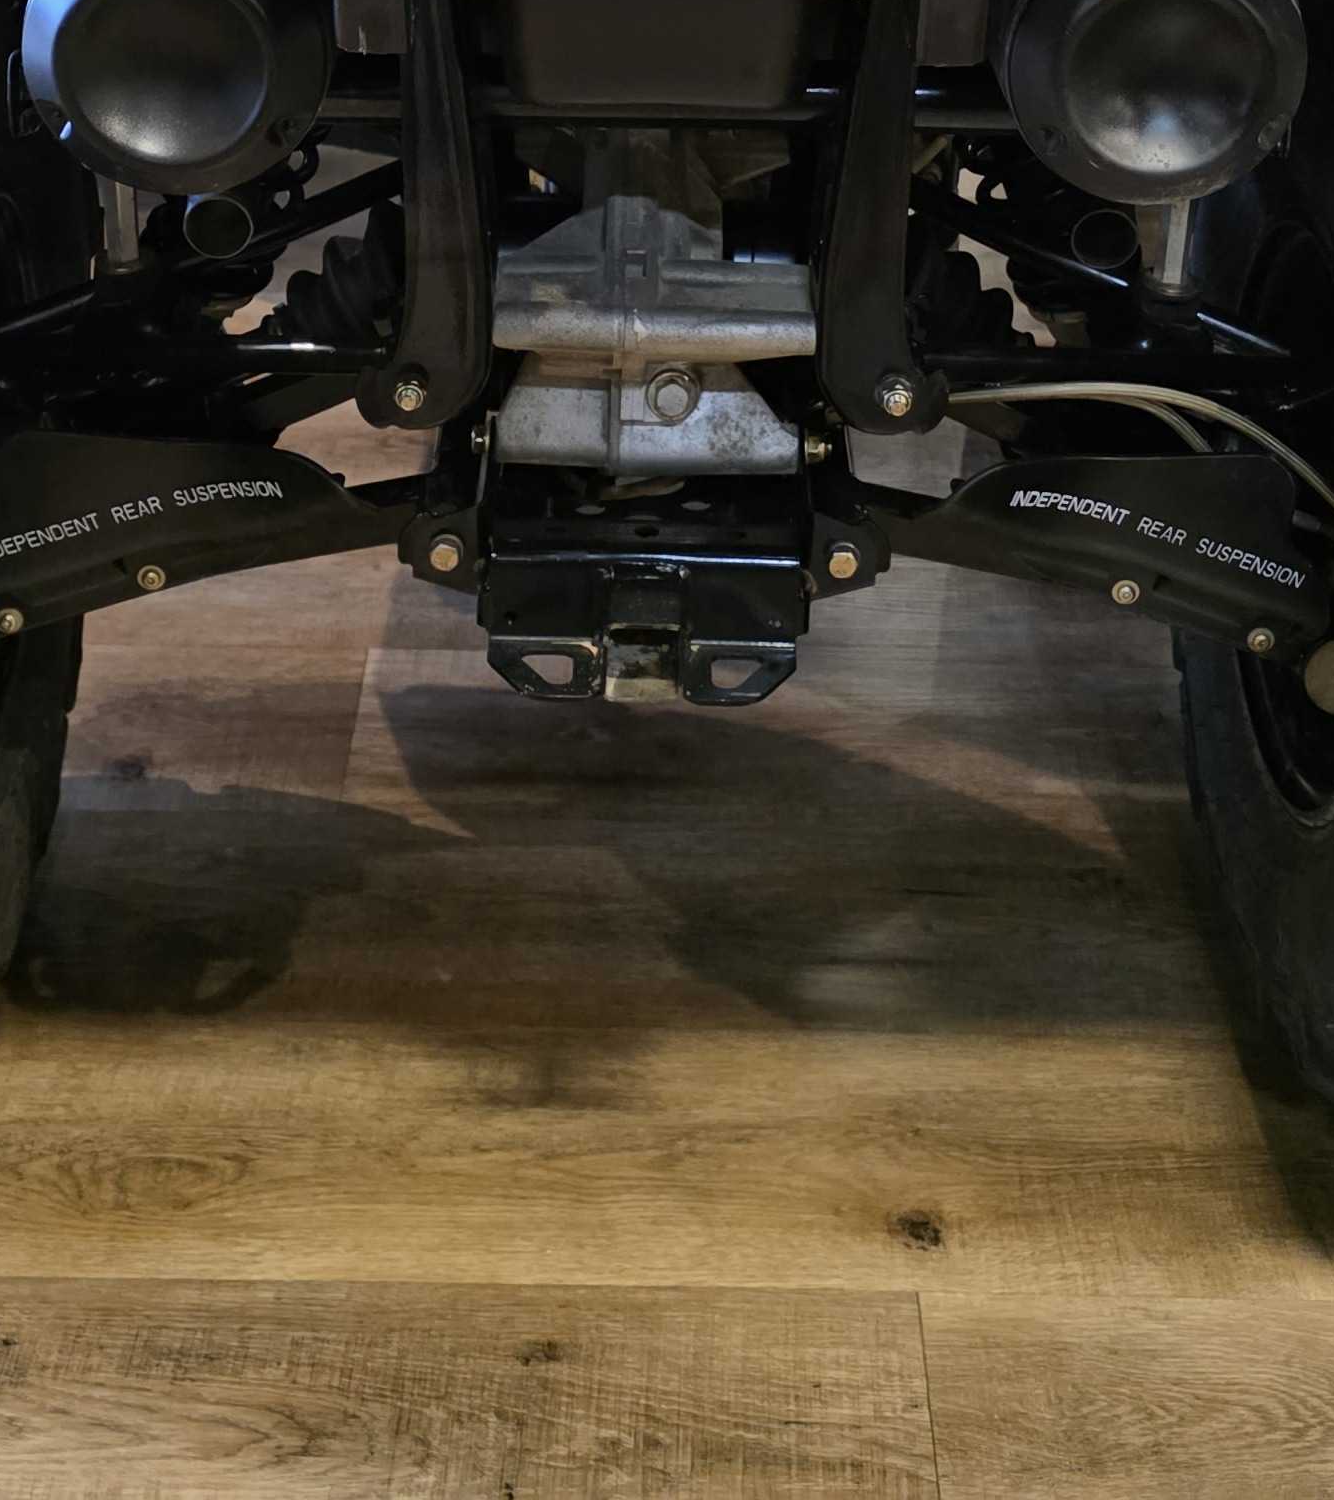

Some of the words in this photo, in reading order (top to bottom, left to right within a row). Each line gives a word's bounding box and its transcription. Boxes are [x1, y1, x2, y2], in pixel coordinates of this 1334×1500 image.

[110, 496, 163, 524] REAR
[173, 481, 283, 506] SUSPENSION
[1010, 490, 1131, 526] INDEPENDENT
[1136, 517, 1187, 546] REAR
[1196, 538, 1306, 589] SUSPENSION
